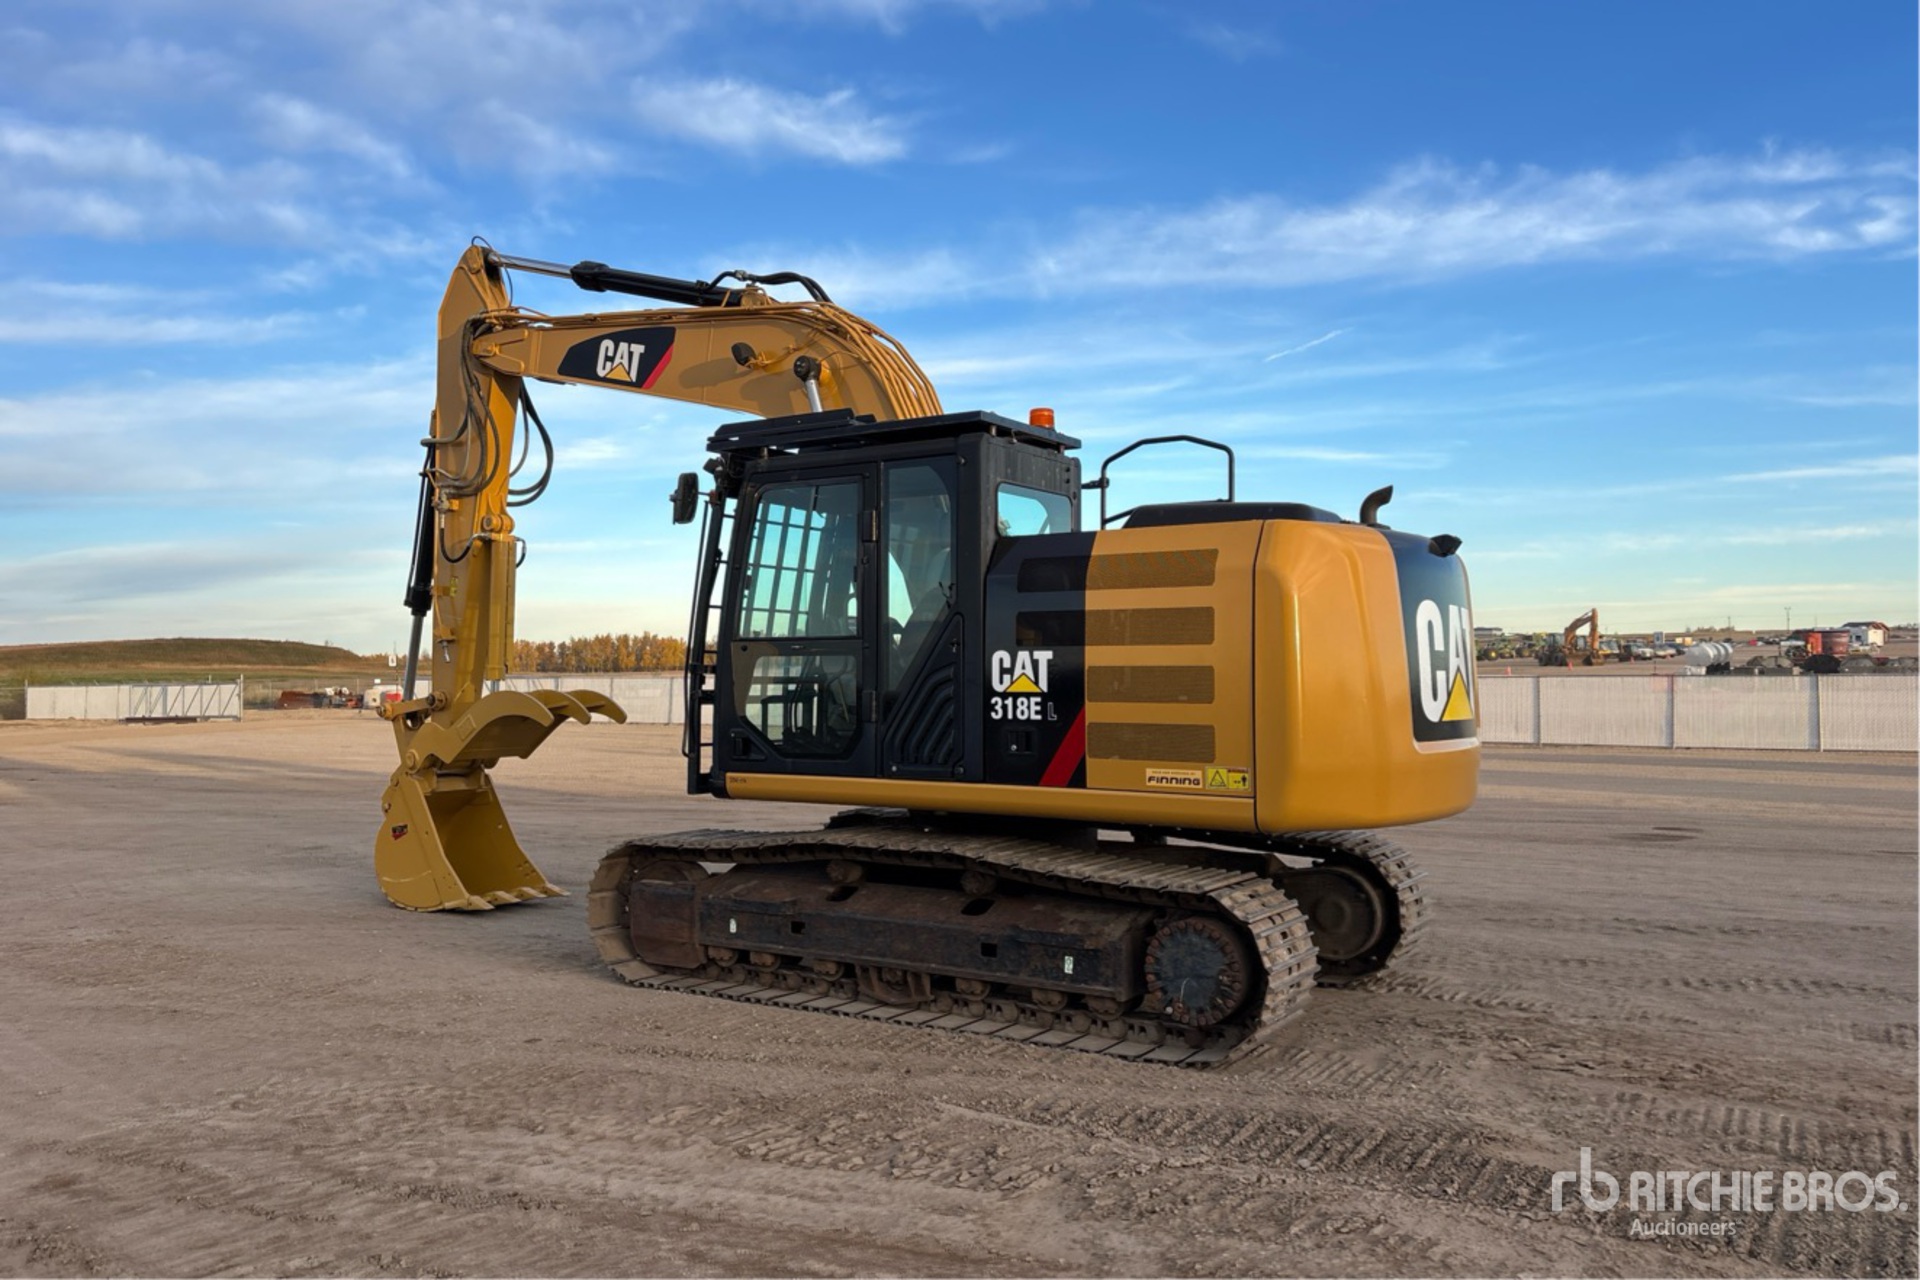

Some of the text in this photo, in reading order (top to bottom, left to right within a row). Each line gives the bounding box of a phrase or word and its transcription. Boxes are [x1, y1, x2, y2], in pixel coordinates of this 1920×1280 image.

[596, 339, 645, 382] CAT
[991, 650, 1053, 692] CAT
[990, 696, 1057, 720] 318E L
[1148, 775, 1200, 786] FINNING
